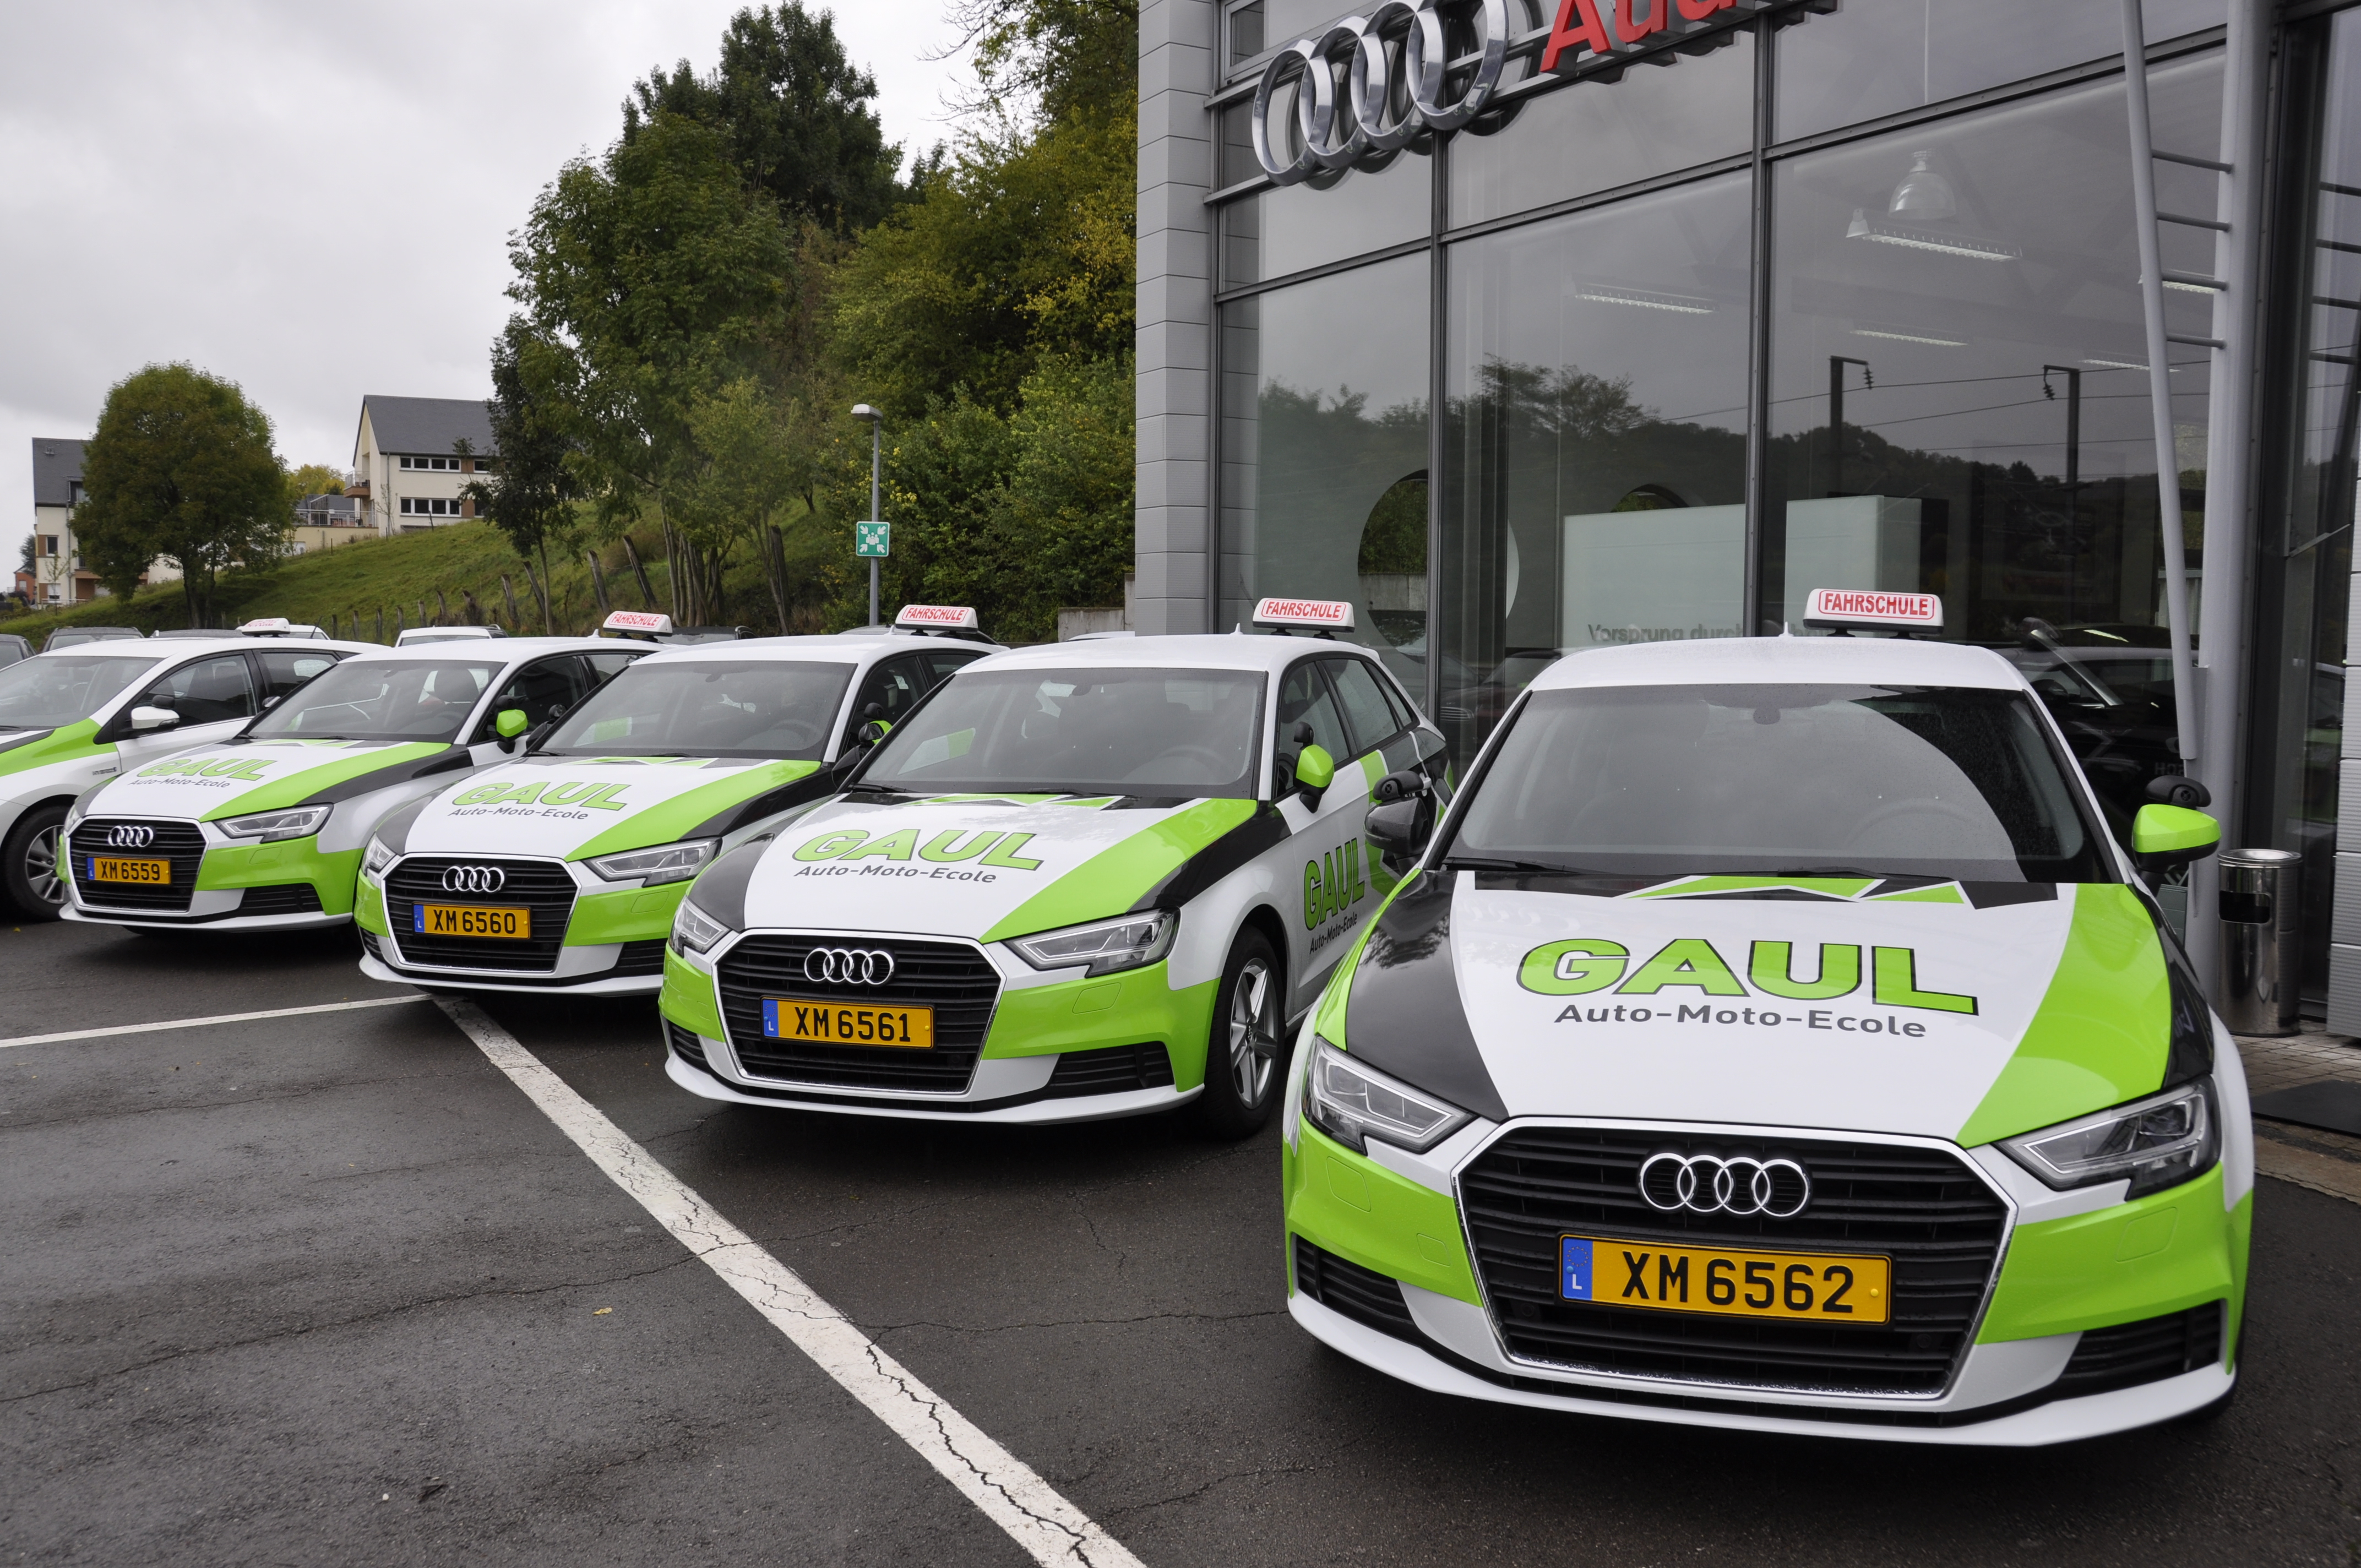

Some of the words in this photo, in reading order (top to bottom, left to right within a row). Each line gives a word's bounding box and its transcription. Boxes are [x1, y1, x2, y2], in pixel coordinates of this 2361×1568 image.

[1539, 0, 1737, 73] Au
[905, 607, 965, 620] FAHRSCHULE
[1265, 601, 1342, 618] FAHRSCHULE
[1824, 592, 1928, 616] FAHRSCHULE
[611, 613, 660, 626] FAHRSCHULE
[127, 777, 231, 788] Auto-Moto-Ecole
[137, 758, 279, 781] GAUL
[452, 781, 632, 812] GAUL
[447, 807, 589, 821] Auto-Moto-Ecole
[792, 829, 1045, 871] GAUL
[101, 861, 118, 879] XM
[121, 862, 160, 881] 6559
[793, 864, 997, 884] Auto-Moto-Ecole
[1304, 837, 1365, 931] GAUL
[417, 919, 422, 928] L
[433, 909, 458, 932] XM
[463, 911, 516, 935] 6560
[1309, 911, 1358, 955] Auto-Moto-Ecole
[1516, 938, 1979, 1016] GAUL
[768, 1021, 774, 1032] L
[795, 1006, 830, 1038] XM
[837, 1010, 911, 1043] 6561
[1553, 1003, 1927, 1038] Auto-Moto-Ecole
[1571, 1273, 1582, 1291] L
[1622, 1250, 1689, 1303] XM
[1706, 1259, 1854, 1314] 6562
